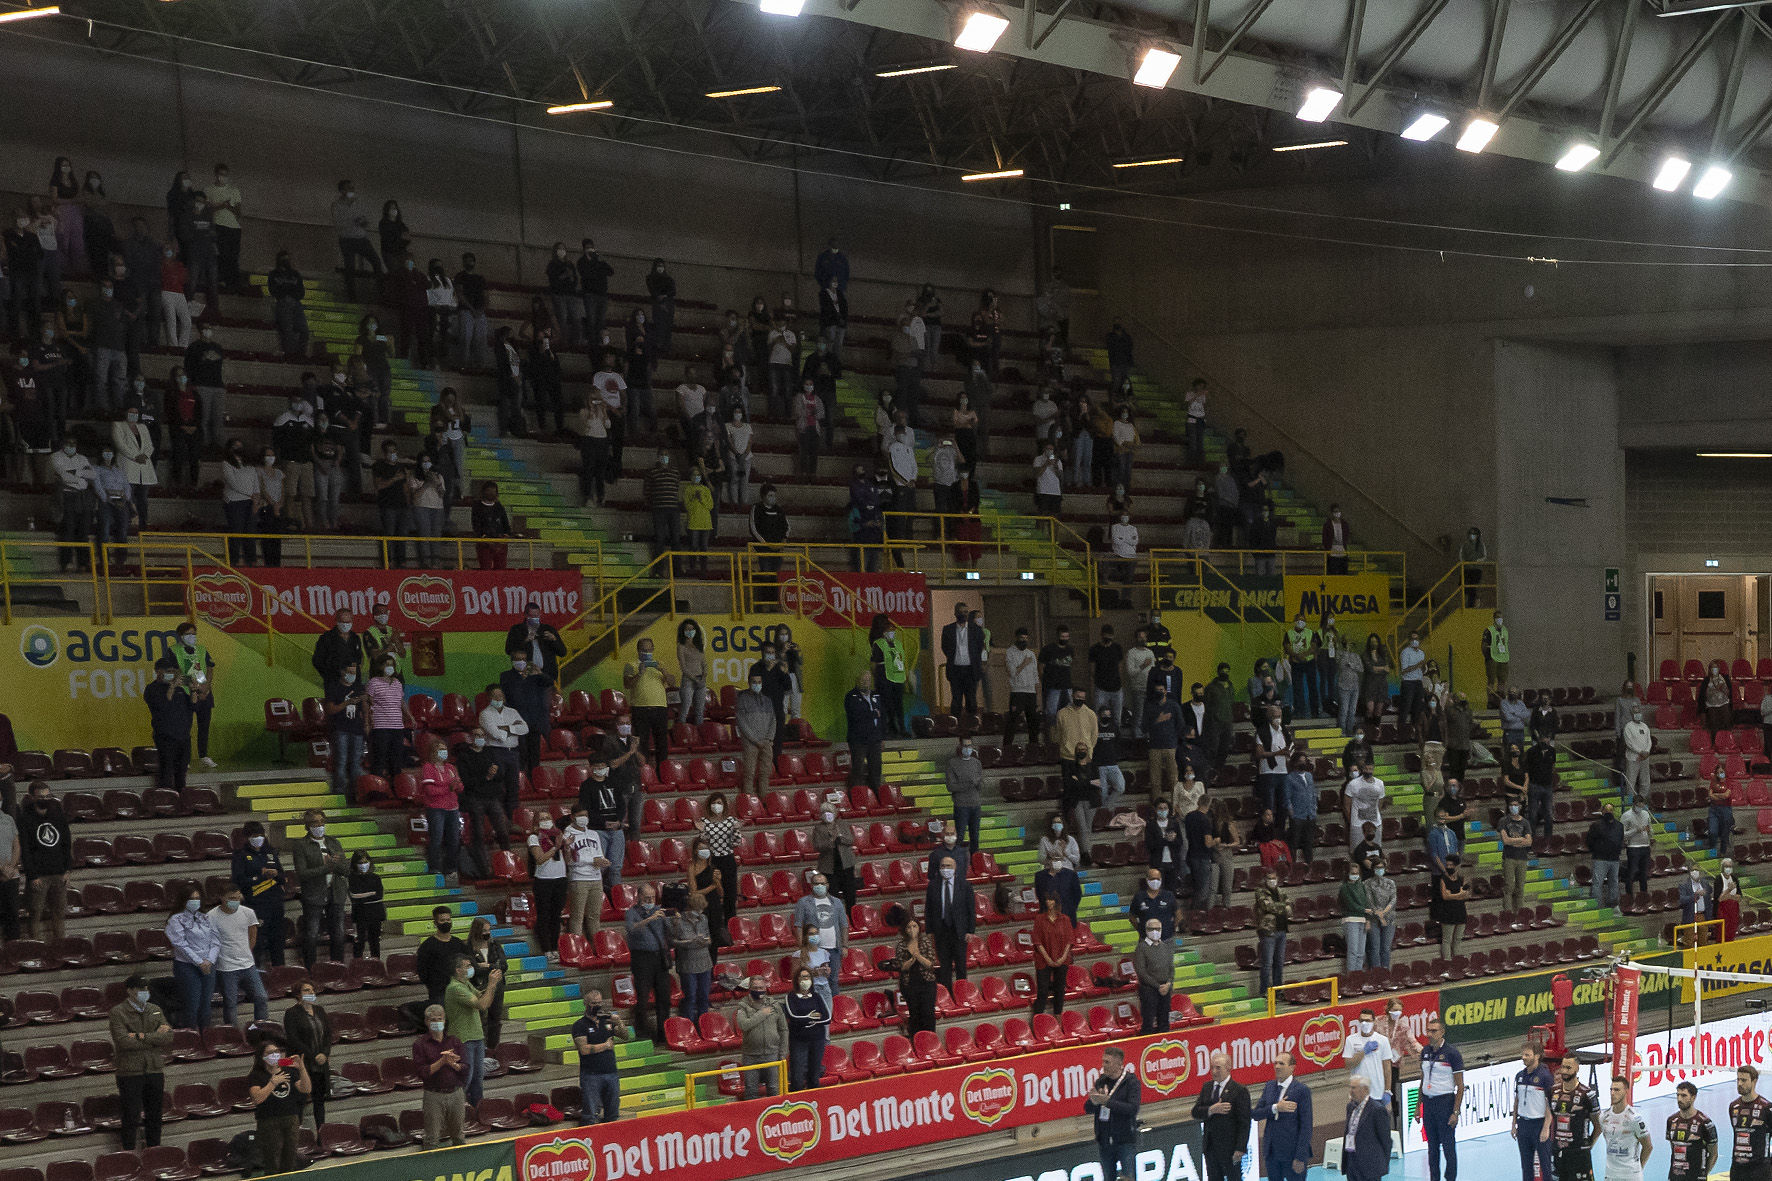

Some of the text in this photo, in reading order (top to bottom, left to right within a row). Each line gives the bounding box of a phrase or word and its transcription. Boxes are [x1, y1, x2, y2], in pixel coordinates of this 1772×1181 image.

[262, 585, 391, 615] Del Monte
[404, 592, 451, 605] Del Monte
[461, 586, 578, 614] Del Monte
[831, 586, 925, 613] Del Monte
[1301, 591, 1380, 615] MIKASA
[69, 669, 157, 698] FORU
[1445, 991, 1554, 1026] CREDEM BANC
[1620, 1012, 1628, 1025] Del
[1232, 1033, 1296, 1070] Monte
[1303, 1030, 1341, 1049] Del Monte
[1145, 1056, 1186, 1074] Del Monte
[1647, 1025, 1765, 1088] Del Monte
[965, 1084, 1013, 1105] Del Monte
[1022, 1069, 1059, 1107] Del
[828, 1092, 955, 1142] Del Monte
[1561, 1102, 1566, 1113] 5
[763, 1119, 815, 1139] Del Monte
[1741, 1117, 1746, 1127] 2
[602, 1123, 751, 1181] Del Monte
[529, 1157, 590, 1178] Del Monte
